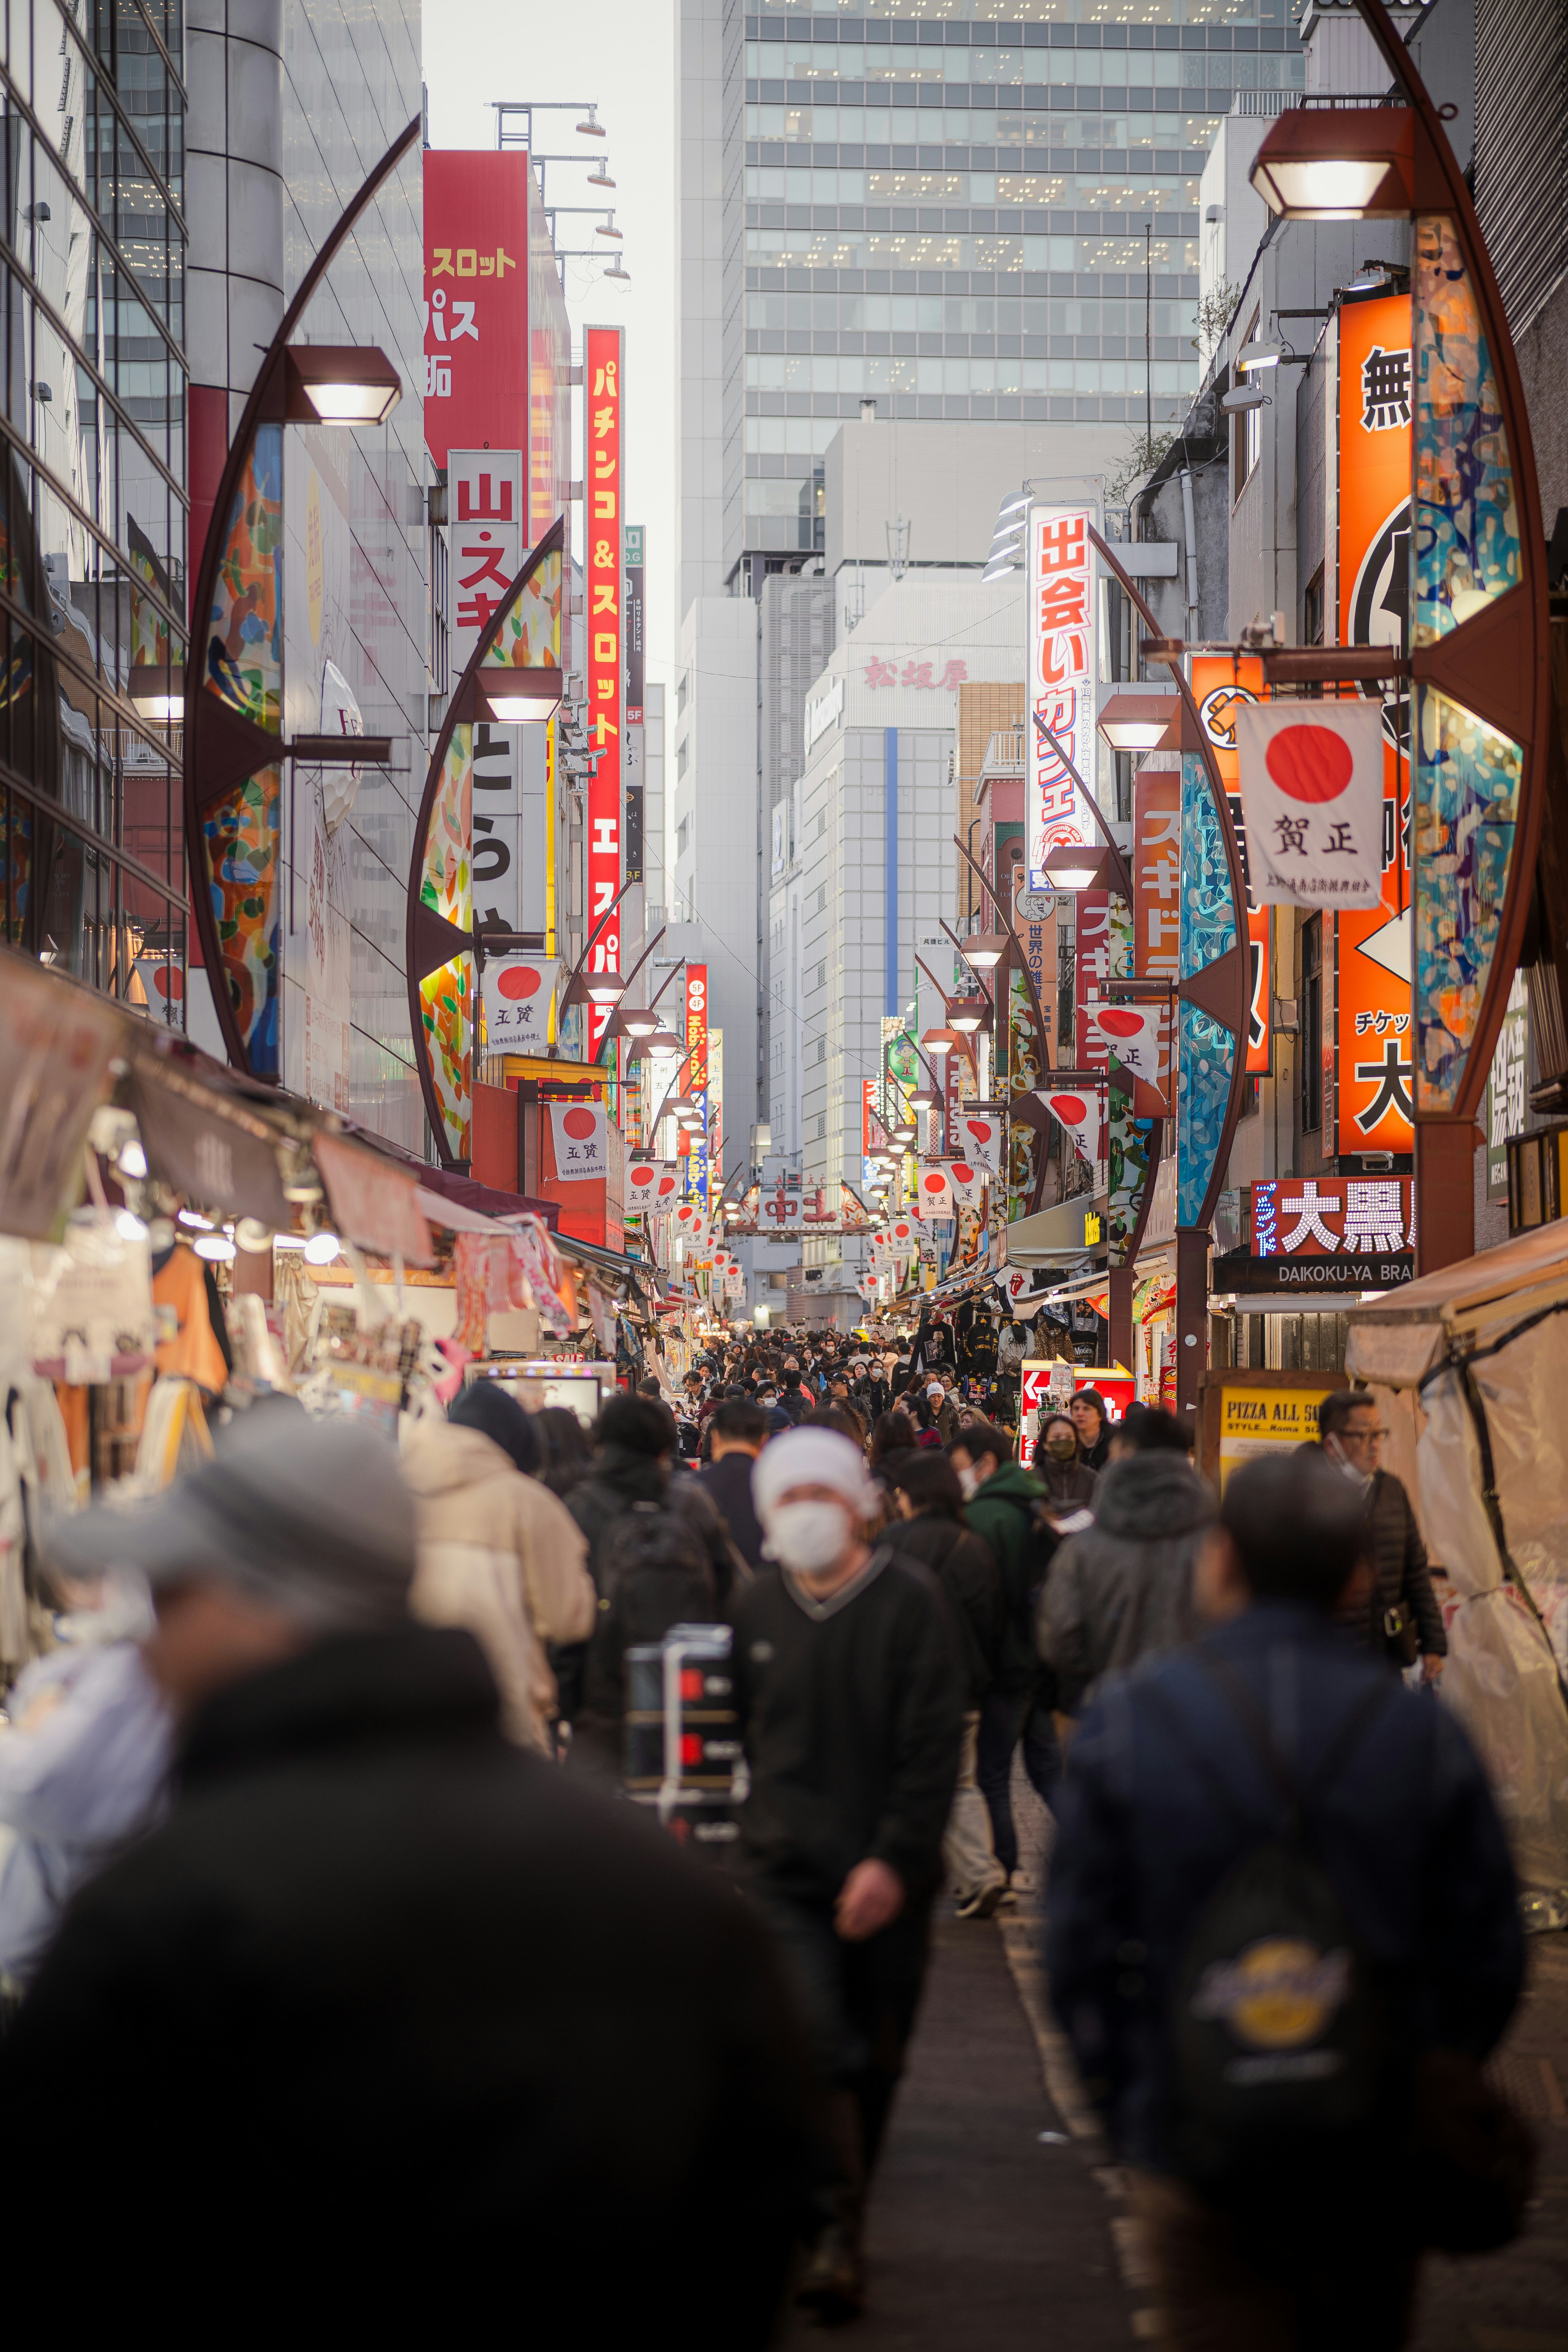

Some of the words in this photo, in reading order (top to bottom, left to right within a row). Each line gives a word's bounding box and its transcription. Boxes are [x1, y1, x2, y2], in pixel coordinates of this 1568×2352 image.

[424, 289, 478, 341] パス
[1359, 346, 1412, 432] 無
[865, 656, 968, 690] 松坂屋
[627, 710, 641, 719] 5F
[1043, 825, 1071, 842] community
[1071, 830, 1080, 842] cafe
[1273, 816, 1358, 856] 賀正
[927, 1197, 947, 1207] 賀正
[1281, 1181, 1416, 1253] 大黒
[1279, 1265, 1372, 1282] DAIKOKU-YA
[555, 1353, 584, 1363] SALE
[1227, 1401, 1267, 1420] PIZZA
[1272, 1403, 1300, 1422] ALL
